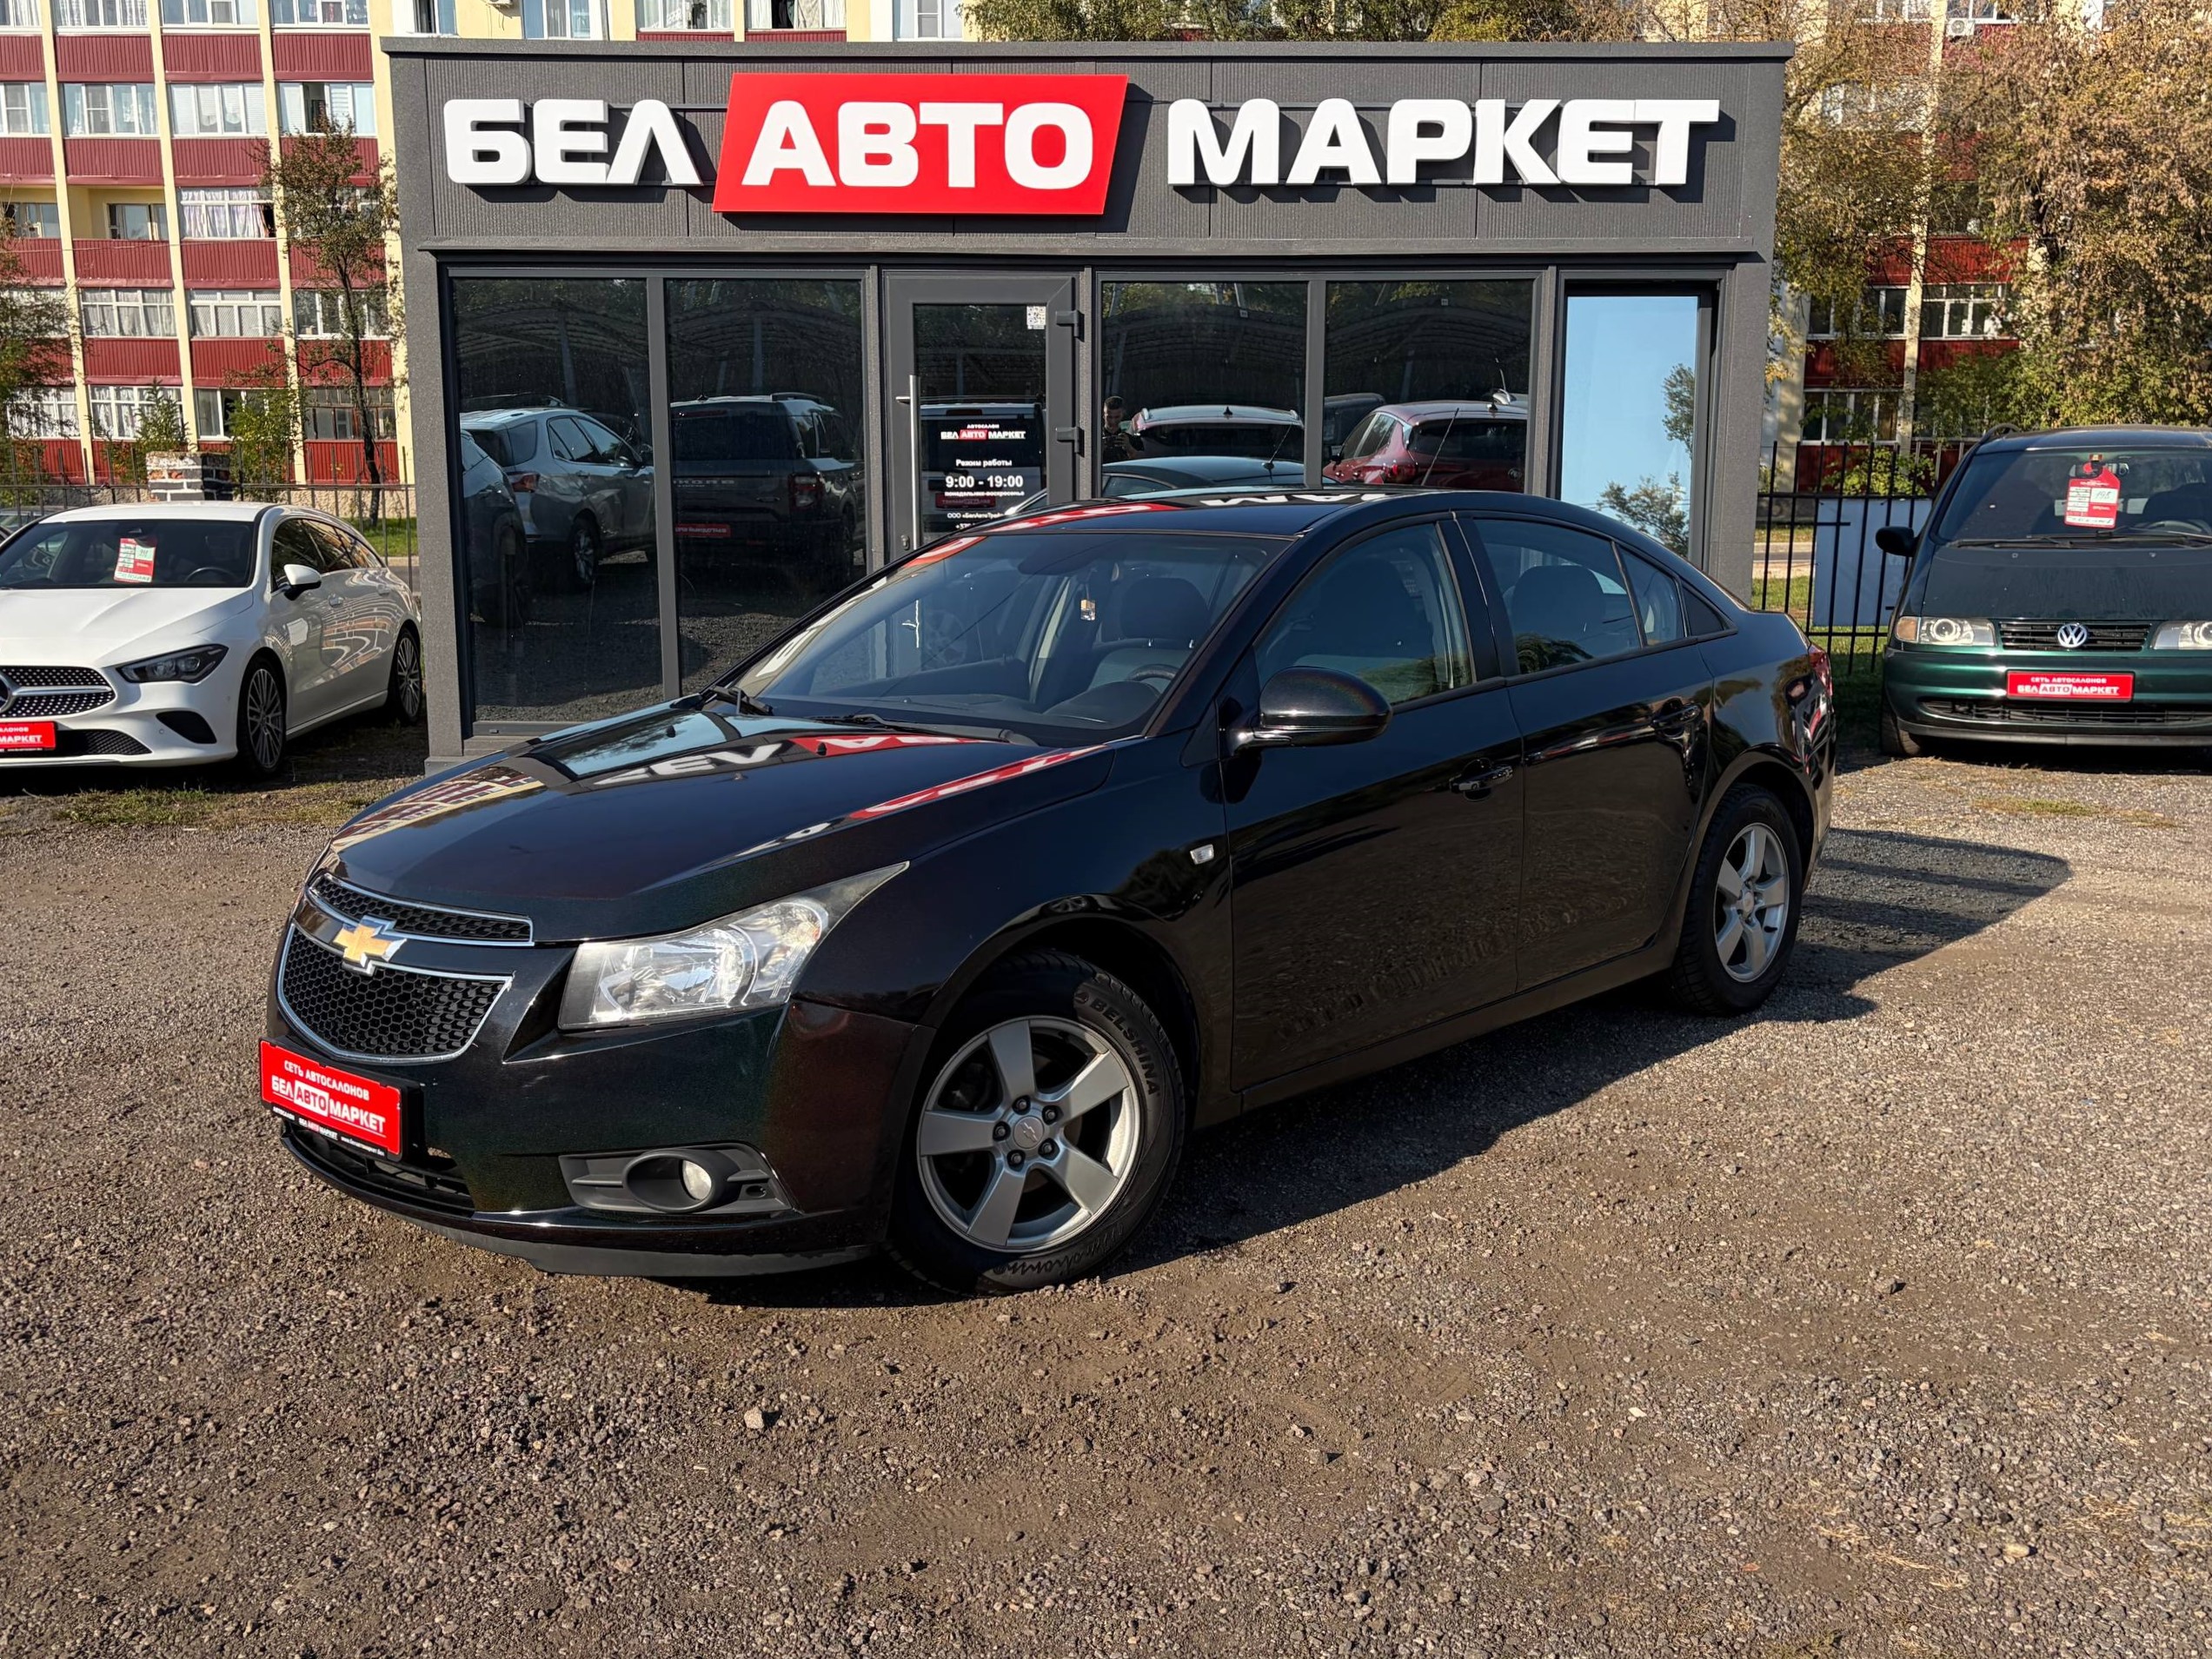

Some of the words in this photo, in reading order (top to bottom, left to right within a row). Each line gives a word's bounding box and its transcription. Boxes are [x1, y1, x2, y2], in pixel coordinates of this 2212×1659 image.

[443, 98, 703, 186] БЕЛ
[741, 100, 1094, 189] АВТО
[1167, 98, 1720, 186] МАРКЕТ
[940, 431, 960, 440] БЕЛ
[988, 431, 1026, 440] МАРКЕТ
[983, 459, 1012, 468] работы
[946, 475, 974, 488] 9:00
[986, 475, 1024, 488] 19:00
[2017, 685, 2039, 694] БЕЛ
[2041, 685, 2070, 693] АВТО
[2072, 686, 2120, 694] МАРКЕТ
[1090, 998, 1160, 1095] BELSHINA
[283, 1059, 304, 1078] СЕТЬ
[305, 1069, 369, 1101] АВТОСАЛОНОВ
[271, 1075, 294, 1099] БЕЛ
[296, 1082, 327, 1111] АВТО
[329, 1098, 386, 1133] МАРКЕТ
